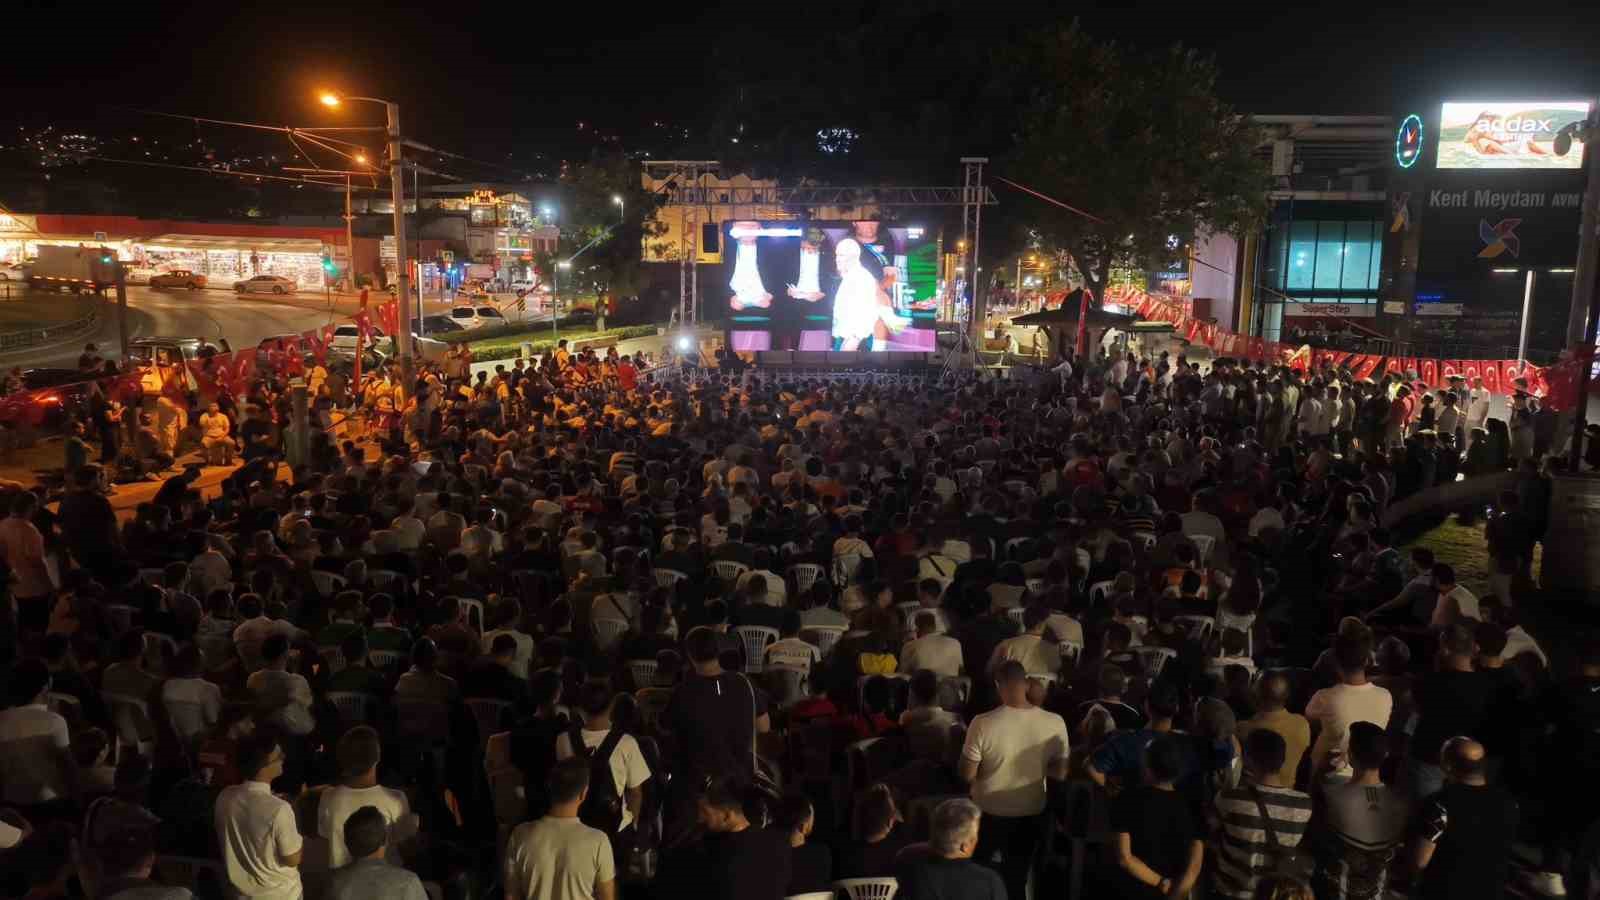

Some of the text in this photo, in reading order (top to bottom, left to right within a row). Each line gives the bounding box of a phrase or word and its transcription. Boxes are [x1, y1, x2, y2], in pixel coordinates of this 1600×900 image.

[1478, 114, 1552, 132] addax
[1429, 189, 1468, 208] Kent
[1551, 192, 1580, 207] AVM
